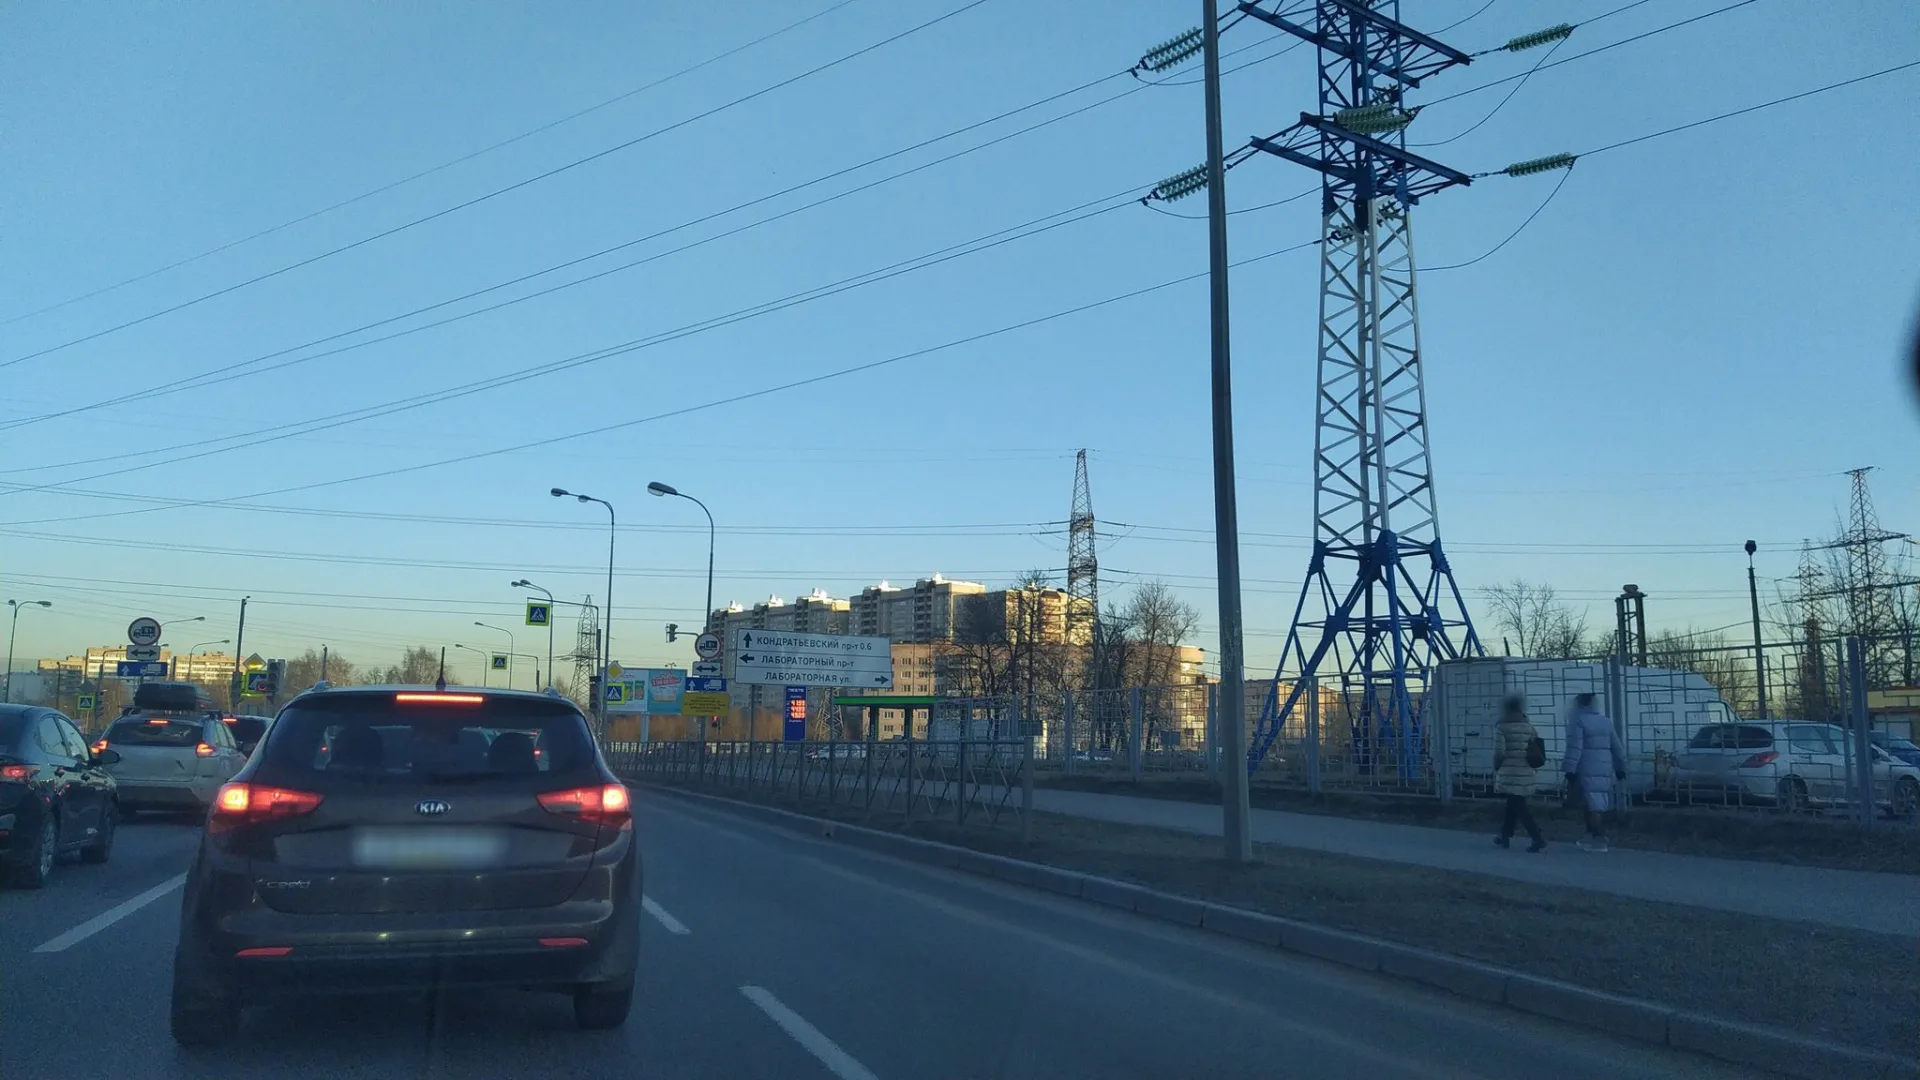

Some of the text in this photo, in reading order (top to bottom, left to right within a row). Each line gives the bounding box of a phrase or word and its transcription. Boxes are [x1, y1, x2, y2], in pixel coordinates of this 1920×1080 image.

[756, 637, 839, 649] КОНДРАТЬЕВСКИЙ
[841, 643, 858, 651] пр-т
[761, 655, 854, 669] ЛАБОРАТОРНЫЙ пр-т
[764, 672, 837, 683] ЛАБОРАТОРНАЯ
[420, 802, 446, 813] KIA
